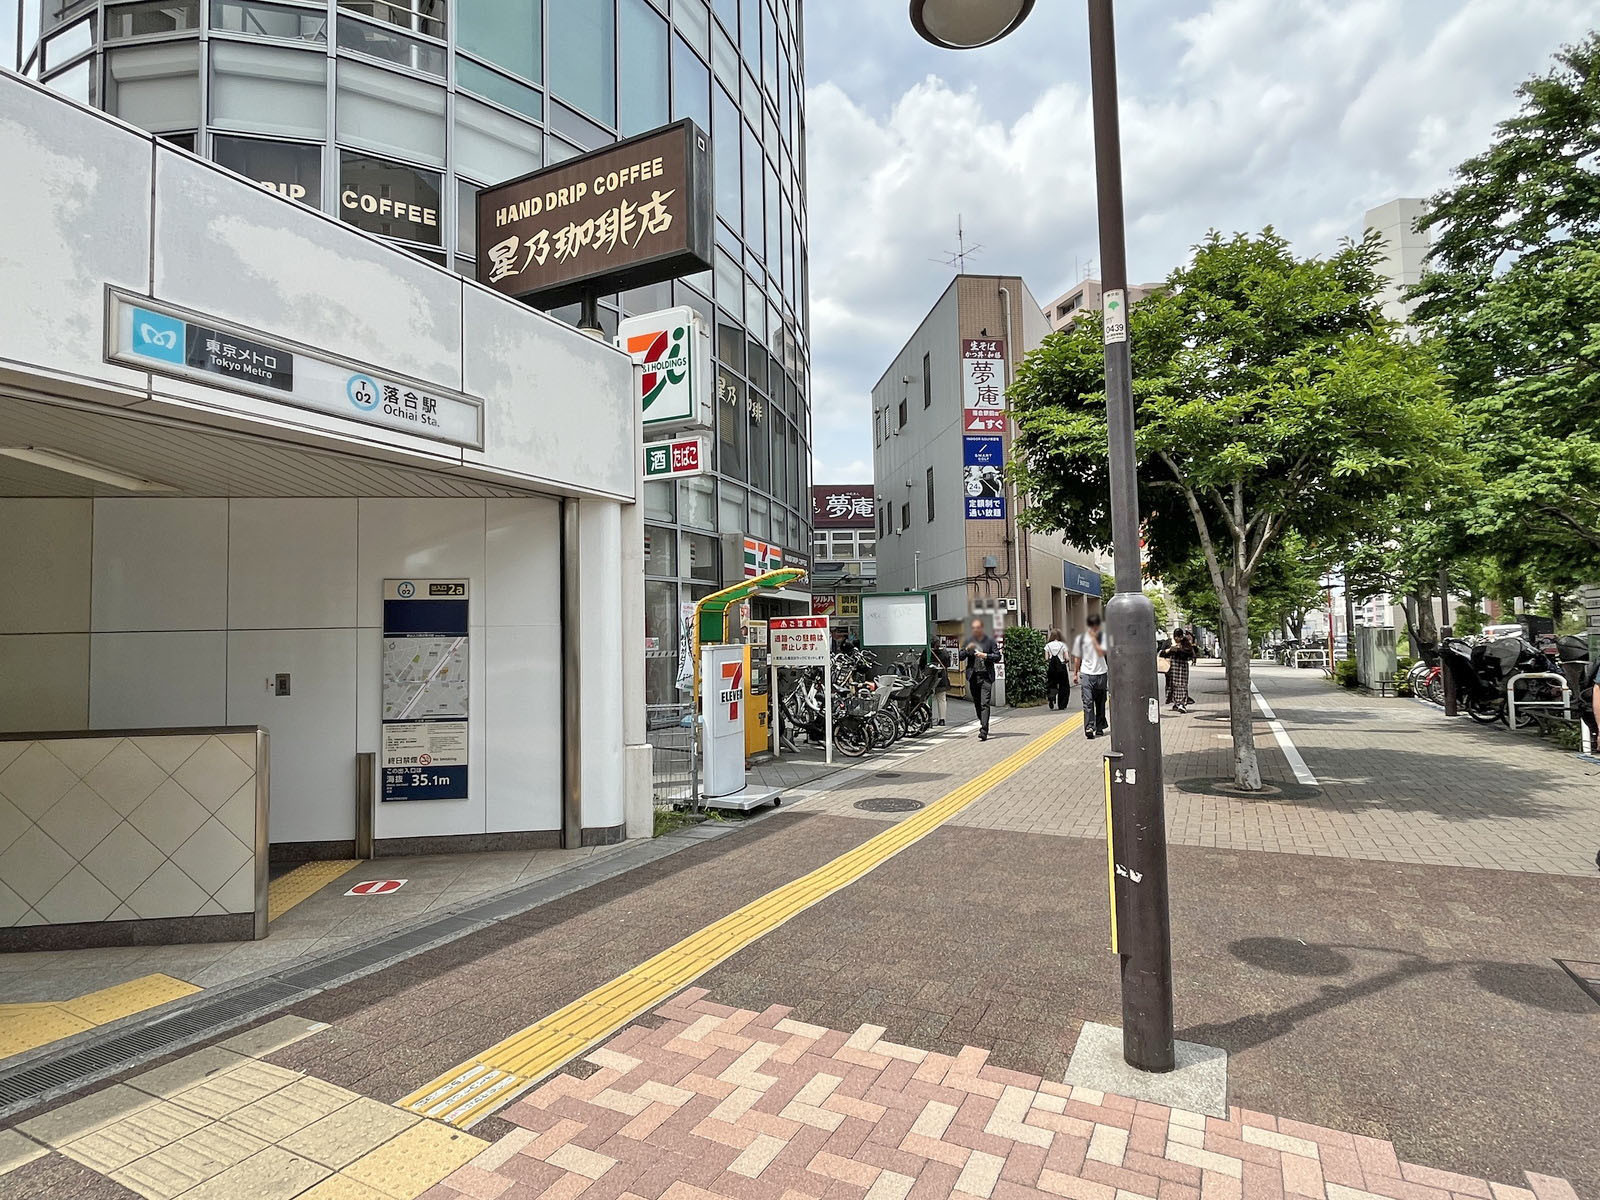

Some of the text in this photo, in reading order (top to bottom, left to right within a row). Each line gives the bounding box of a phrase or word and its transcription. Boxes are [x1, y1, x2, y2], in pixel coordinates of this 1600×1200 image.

[495, 157, 664, 227] HAND DRIP COFFEE
[342, 190, 437, 226] COFFEE
[487, 189, 676, 284] 星乃珈琲店
[1105, 323, 1124, 334] 0439
[205, 338, 277, 369] 東京メトロ
[210, 354, 273, 379] Tokyo Metro
[651, 357, 687, 371] HOLDINGS
[360, 381, 367, 391] T
[971, 361, 999, 407] 夢庵
[355, 391, 372, 404] 02
[383, 385, 437, 415] 落合駅
[383, 404, 440, 427] Ochiai Sta.
[985, 419, 1003, 429] すぐ
[650, 446, 698, 471] 酒 たばこ
[825, 493, 874, 519] 夢庵
[969, 500, 1000, 508] 定額制で
[969, 508, 1001, 517] 通い放題
[448, 584, 463, 594] 2a
[813, 595, 835, 603] ツルハ
[774, 634, 824, 642] 通路への駐輪は
[781, 643, 818, 651] 禁止します。
[411, 774, 450, 786] 35.1m
